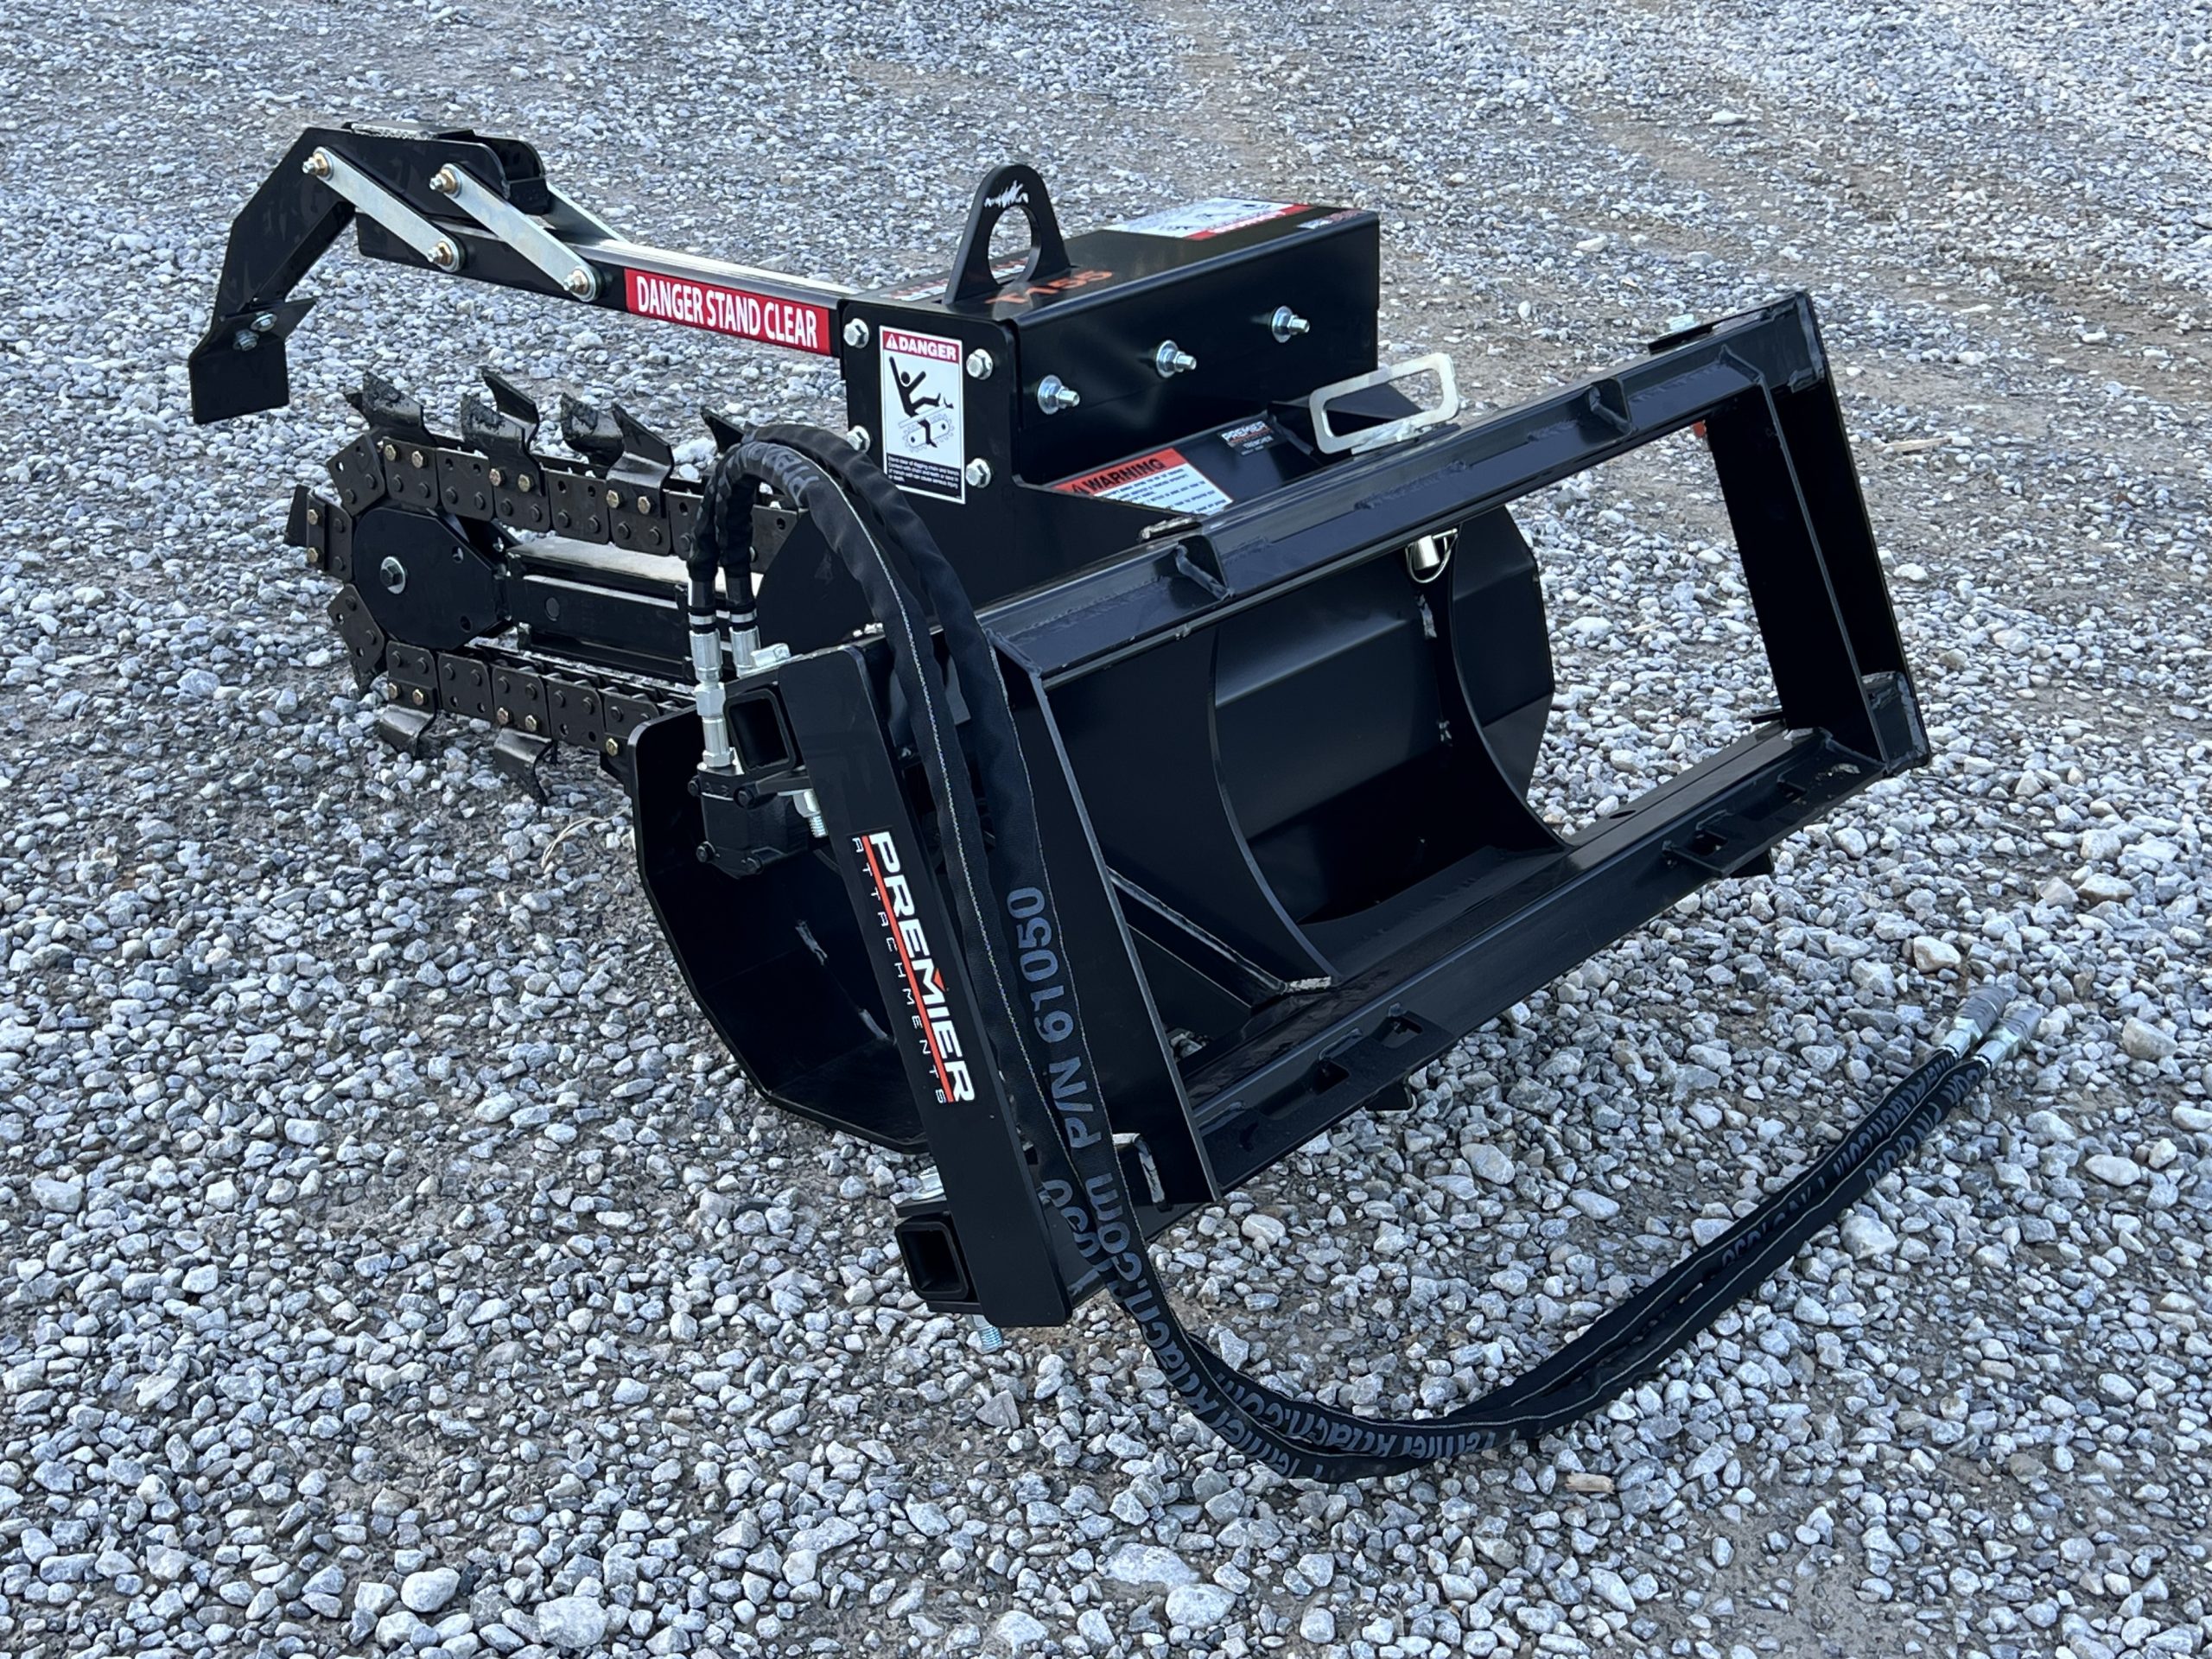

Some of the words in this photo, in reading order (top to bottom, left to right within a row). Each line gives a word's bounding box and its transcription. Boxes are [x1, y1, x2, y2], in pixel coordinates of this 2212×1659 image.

[636, 276, 704, 325] DANGER
[705, 289, 761, 336] STAND
[764, 302, 818, 348] CLEAR
[899, 336, 957, 361] DANGER
[1082, 458, 1166, 491] WARNING
[852, 836, 947, 1103] ATTACHMENTS
[869, 831, 976, 1103] PREMIER
[1007, 887, 1075, 1044] 61050
[1048, 1056, 1103, 1149] P/N
